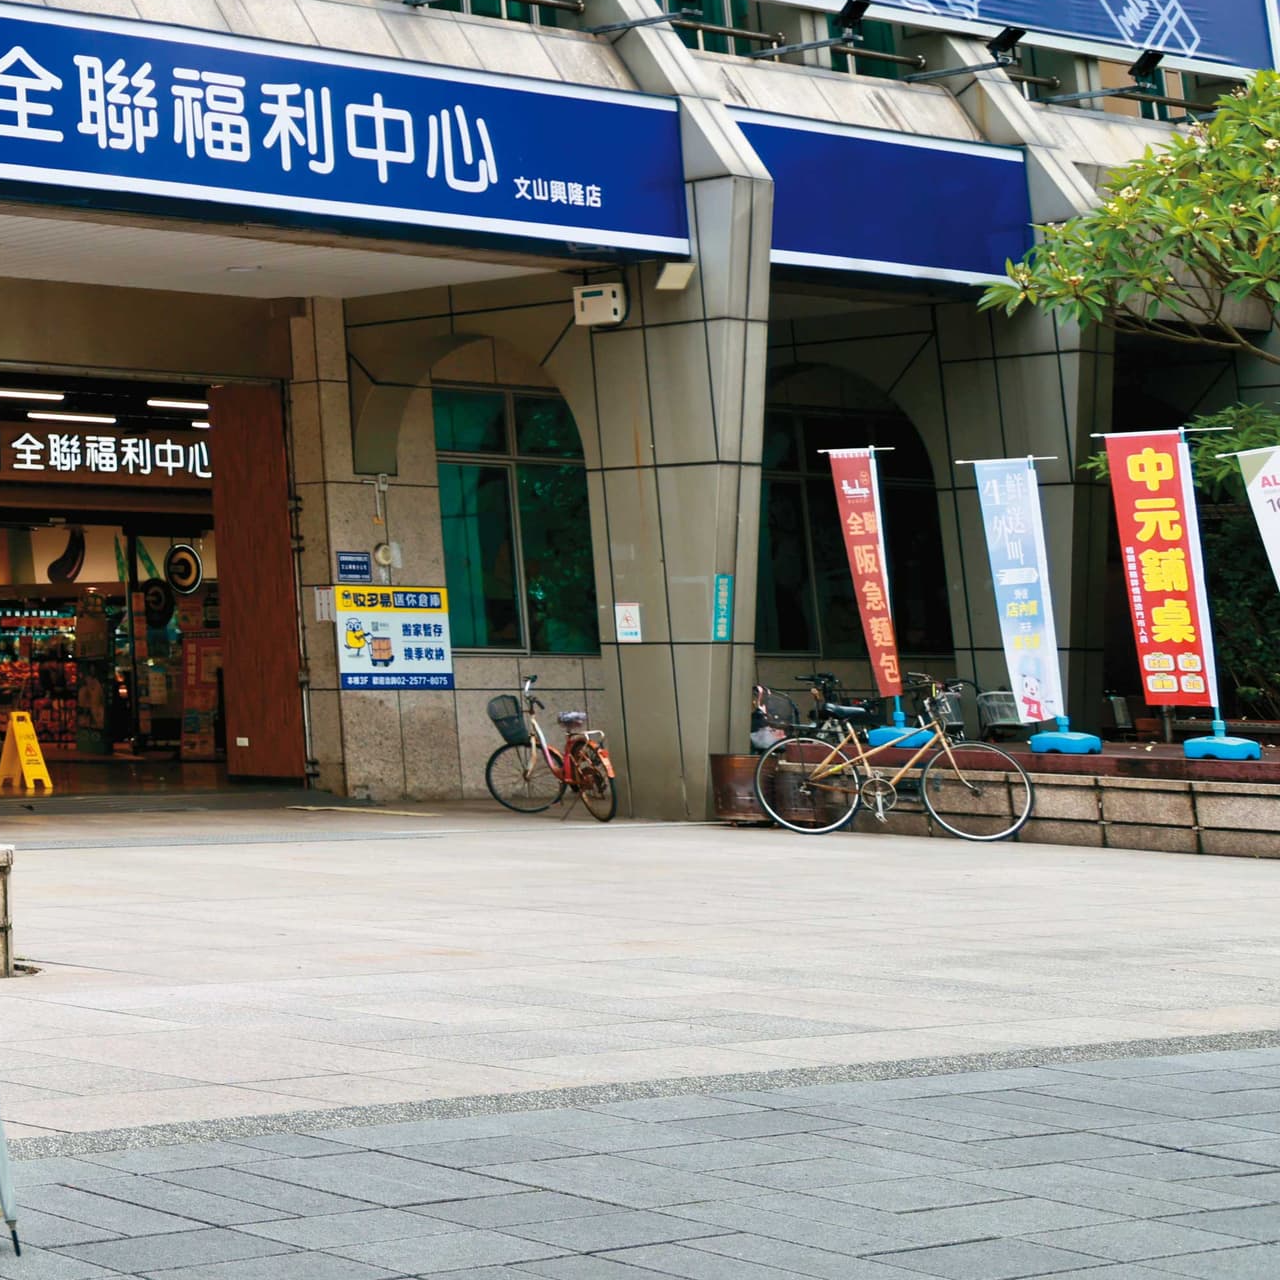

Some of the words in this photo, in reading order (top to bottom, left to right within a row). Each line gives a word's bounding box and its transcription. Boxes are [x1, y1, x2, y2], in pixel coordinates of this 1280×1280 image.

[513, 176, 602, 208] 文山興隆店
[11, 432, 213, 478] 全聯福利中心
[854, 545, 900, 683] 阪急麵包
